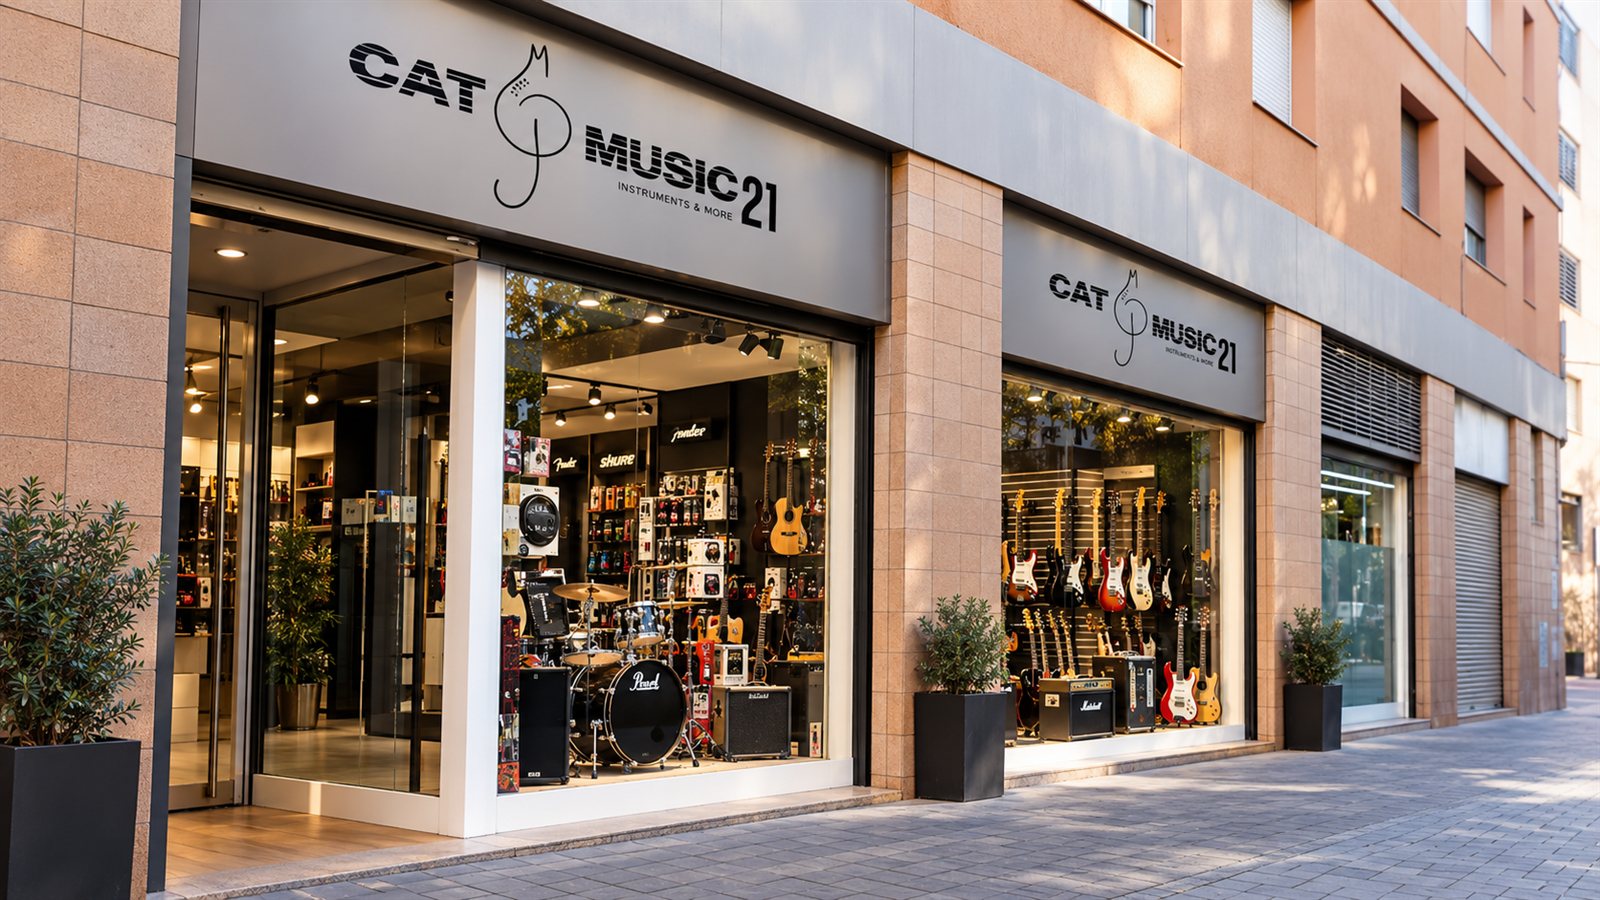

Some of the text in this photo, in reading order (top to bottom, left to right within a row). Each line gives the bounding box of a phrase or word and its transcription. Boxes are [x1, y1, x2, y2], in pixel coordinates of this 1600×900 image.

[349, 42, 486, 114] CAT
[617, 181, 733, 221] INSTRUMENTS & MORE
[1049, 273, 1109, 312] CAT
